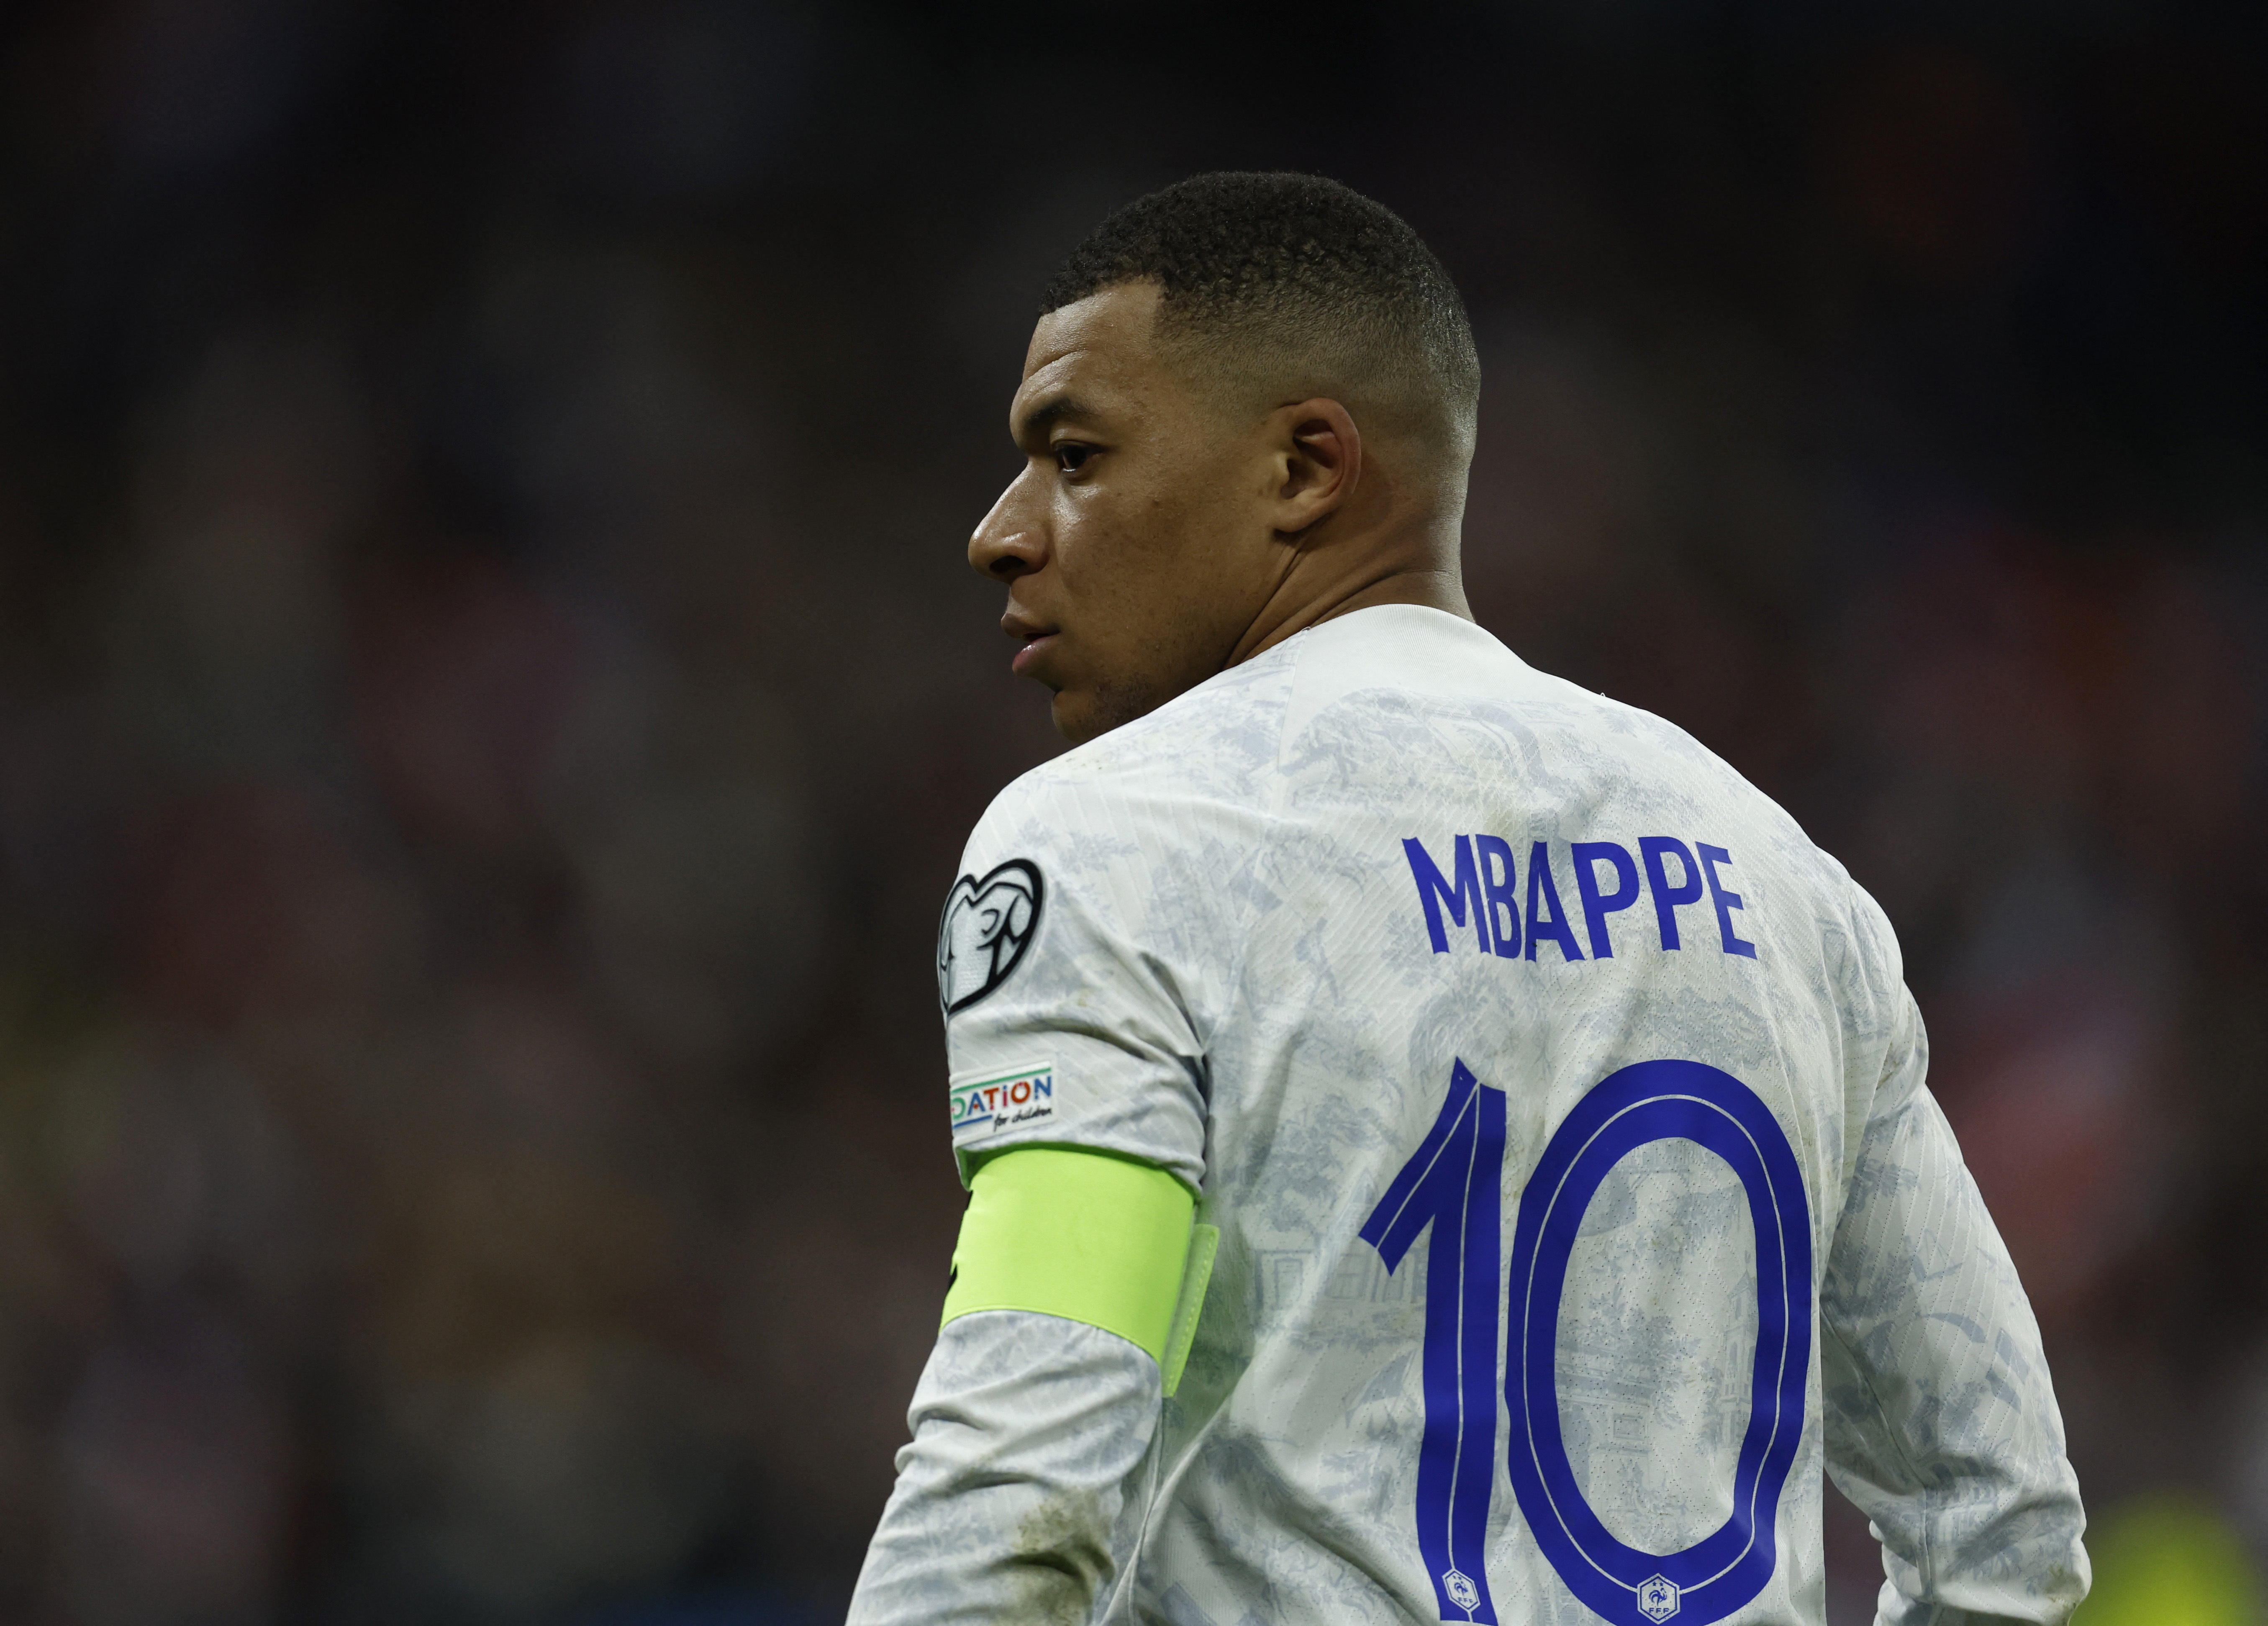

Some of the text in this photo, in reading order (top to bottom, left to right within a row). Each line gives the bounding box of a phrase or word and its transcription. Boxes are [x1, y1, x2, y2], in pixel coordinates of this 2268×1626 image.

[1401, 834, 1757, 962] MBAPPE
[993, 1105, 1052, 1132] for children
[1358, 1056, 1811, 1626] 10
